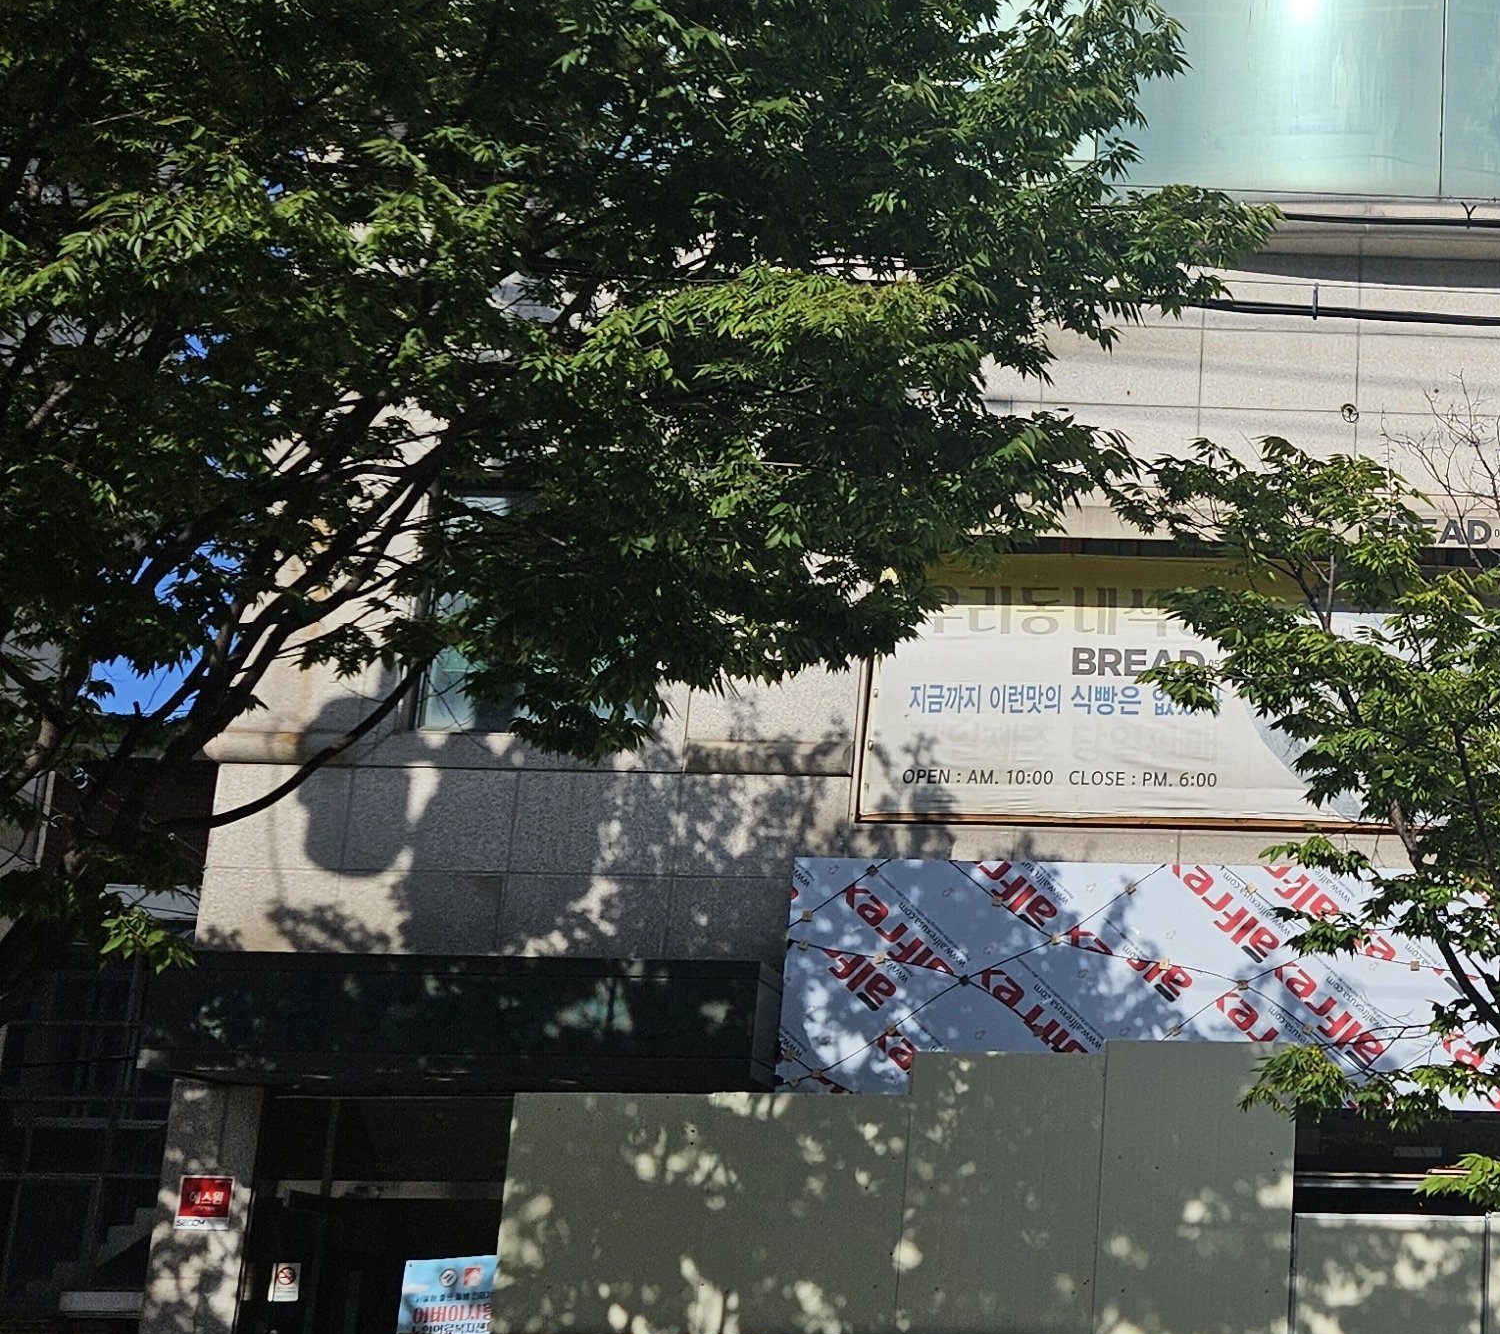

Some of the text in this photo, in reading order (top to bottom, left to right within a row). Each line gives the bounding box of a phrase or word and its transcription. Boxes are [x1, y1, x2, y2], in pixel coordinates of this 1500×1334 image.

[1071, 647, 1207, 677] BREAD
[908, 684, 982, 714] 지금까지
[989, 684, 1062, 714] 이런맛의
[1070, 685, 1142, 716] 식빵은
[902, 769, 950, 785] OPEN
[967, 770, 999, 785] AM.
[1007, 770, 1054, 785] 10:00
[1069, 770, 1126, 787] CLOSE
[1142, 771, 1173, 787] PM.
[1179, 772, 1218, 788] 6:00
